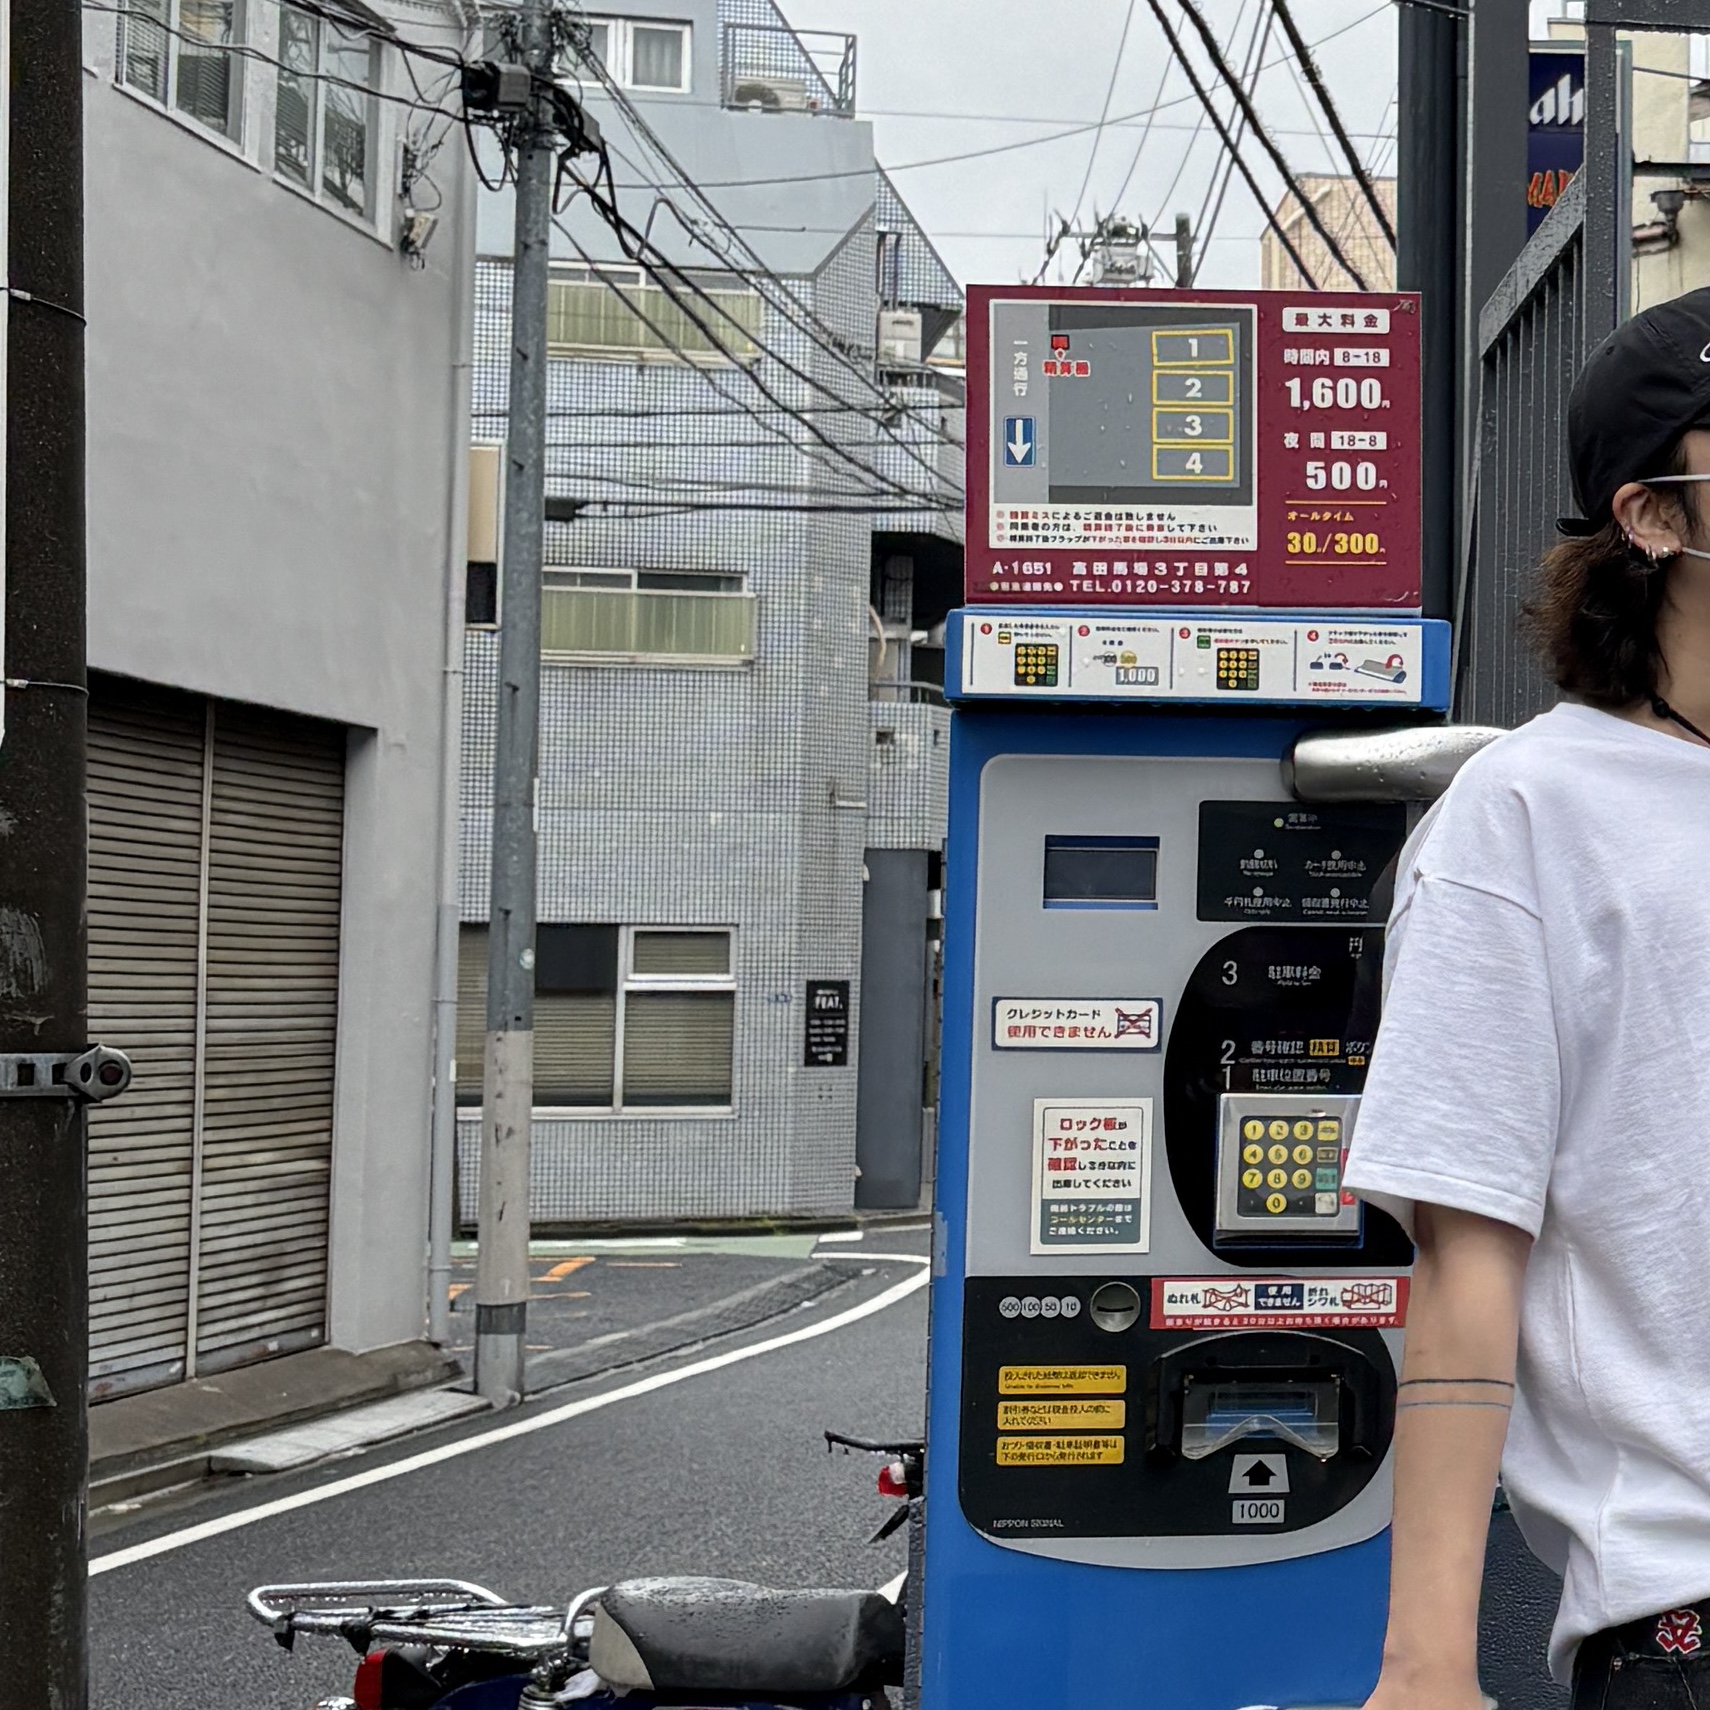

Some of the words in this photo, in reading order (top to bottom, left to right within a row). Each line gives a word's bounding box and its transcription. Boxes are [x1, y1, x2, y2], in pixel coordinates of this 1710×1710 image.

[1295, 312, 1378, 328] 最大料金
[1188, 338, 1198, 358] 1
[1284, 348, 1330, 365] 時間内
[1342, 350, 1381, 363] 8-18
[1013, 340, 1029, 397] 一方通行
[1185, 378, 1202, 397] 2
[1184, 415, 1202, 436] 3
[1339, 435, 1377, 446] 18-8
[1185, 453, 1202, 474] 4
[1287, 511, 1354, 521] オールタイム
[1119, 668, 1155, 682] 1,000
[1222, 960, 1238, 985] 3
[1006, 1008, 1101, 1020] クレジットカード
[1007, 1025, 1112, 1039] 使用できません
[1220, 1039, 1236, 1064] 2
[1222, 1065, 1231, 1090] 1
[1258, 1297, 1301, 1307] できません
[1241, 1502, 1279, 1518] 1000
